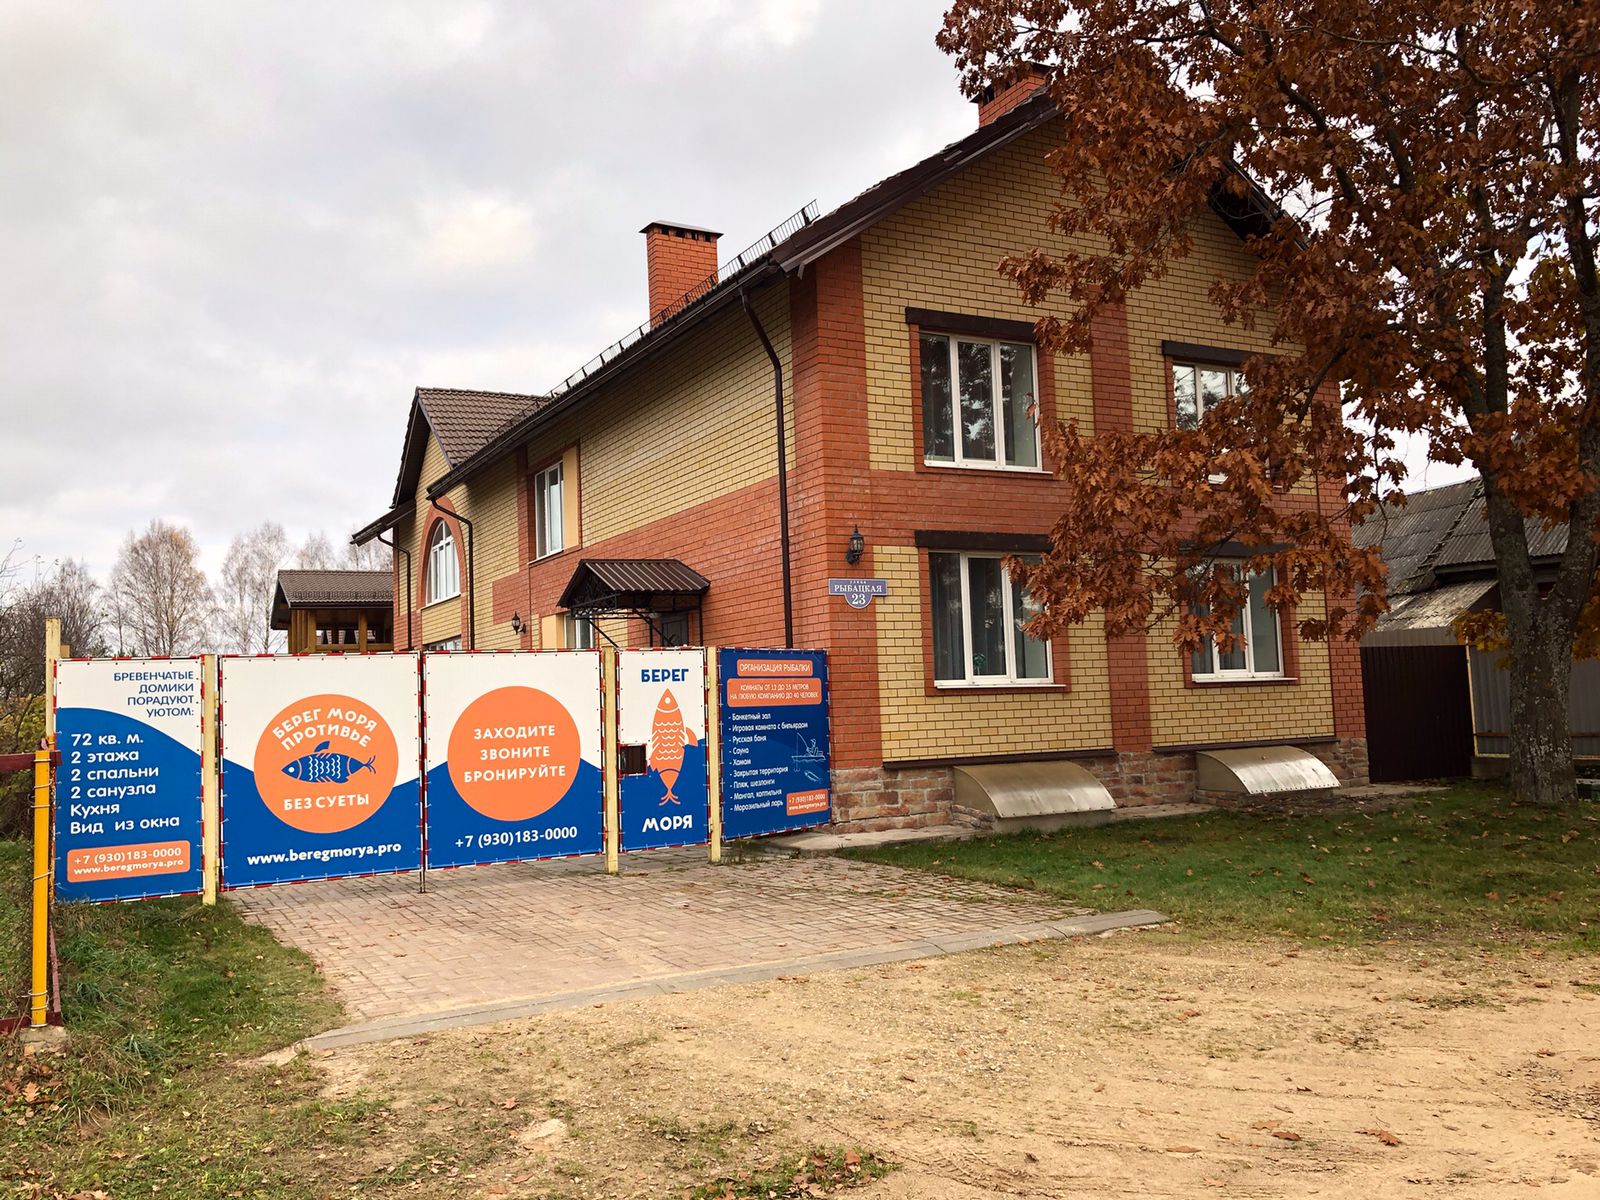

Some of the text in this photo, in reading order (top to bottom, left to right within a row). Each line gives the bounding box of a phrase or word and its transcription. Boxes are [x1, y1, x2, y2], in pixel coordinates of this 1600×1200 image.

[834, 585, 882, 593] РЫБАЦКАЯ
[852, 594, 866, 604] 23
[740, 664, 810, 672] ОРГАНИЗАЦИЯ РЫБАЛКИ
[114, 671, 193, 681] БРЕВЕНЧАТЫЕ
[641, 669, 689, 682] БЕРЕГ
[139, 683, 194, 693] ДОМИКИ
[128, 695, 194, 706] ПОРАДУЮТ
[147, 708, 194, 718] УЮТОМ:
[732, 712, 761, 720] Банкетный
[272, 708, 378, 740] БЕРЕГ МОРЯ
[732, 725, 754, 733] Игровая
[781, 722, 808, 730] бильярдом
[281, 724, 372, 751] ПРОТИВЬЕ
[474, 725, 555, 740] ЗАХОДИТЕ
[71, 733, 144, 746] 72 кв. м.
[733, 736, 753, 744] Русская
[71, 750, 138, 764] 2 этажа
[480, 746, 550, 760] ЗВОНИТЕ
[733, 747, 749, 756] Сауна
[71, 766, 159, 781] 2 спальни
[464, 765, 566, 782] БРОНИРУЙТЕ
[733, 766, 788, 778] Закрытая территория
[734, 779, 775, 789] Пляж, шезлонги
[71, 783, 156, 800] 2 санузла
[734, 789, 782, 800] Мангал, коптильня
[284, 794, 369, 810] БЕЗ СУЕТЫ
[734, 800, 783, 812] Морозильный ларь
[71, 804, 120, 818] Кухня
[71, 816, 180, 835] Вид из окна
[642, 815, 693, 832] МОРЯ
[456, 826, 577, 848] +7 (930)183-0000
[74, 848, 181, 864] +7 (930)183-0000
[247, 844, 401, 865] www.beregmorya.pro
[74, 858, 184, 875] www.beregmorya.pro
